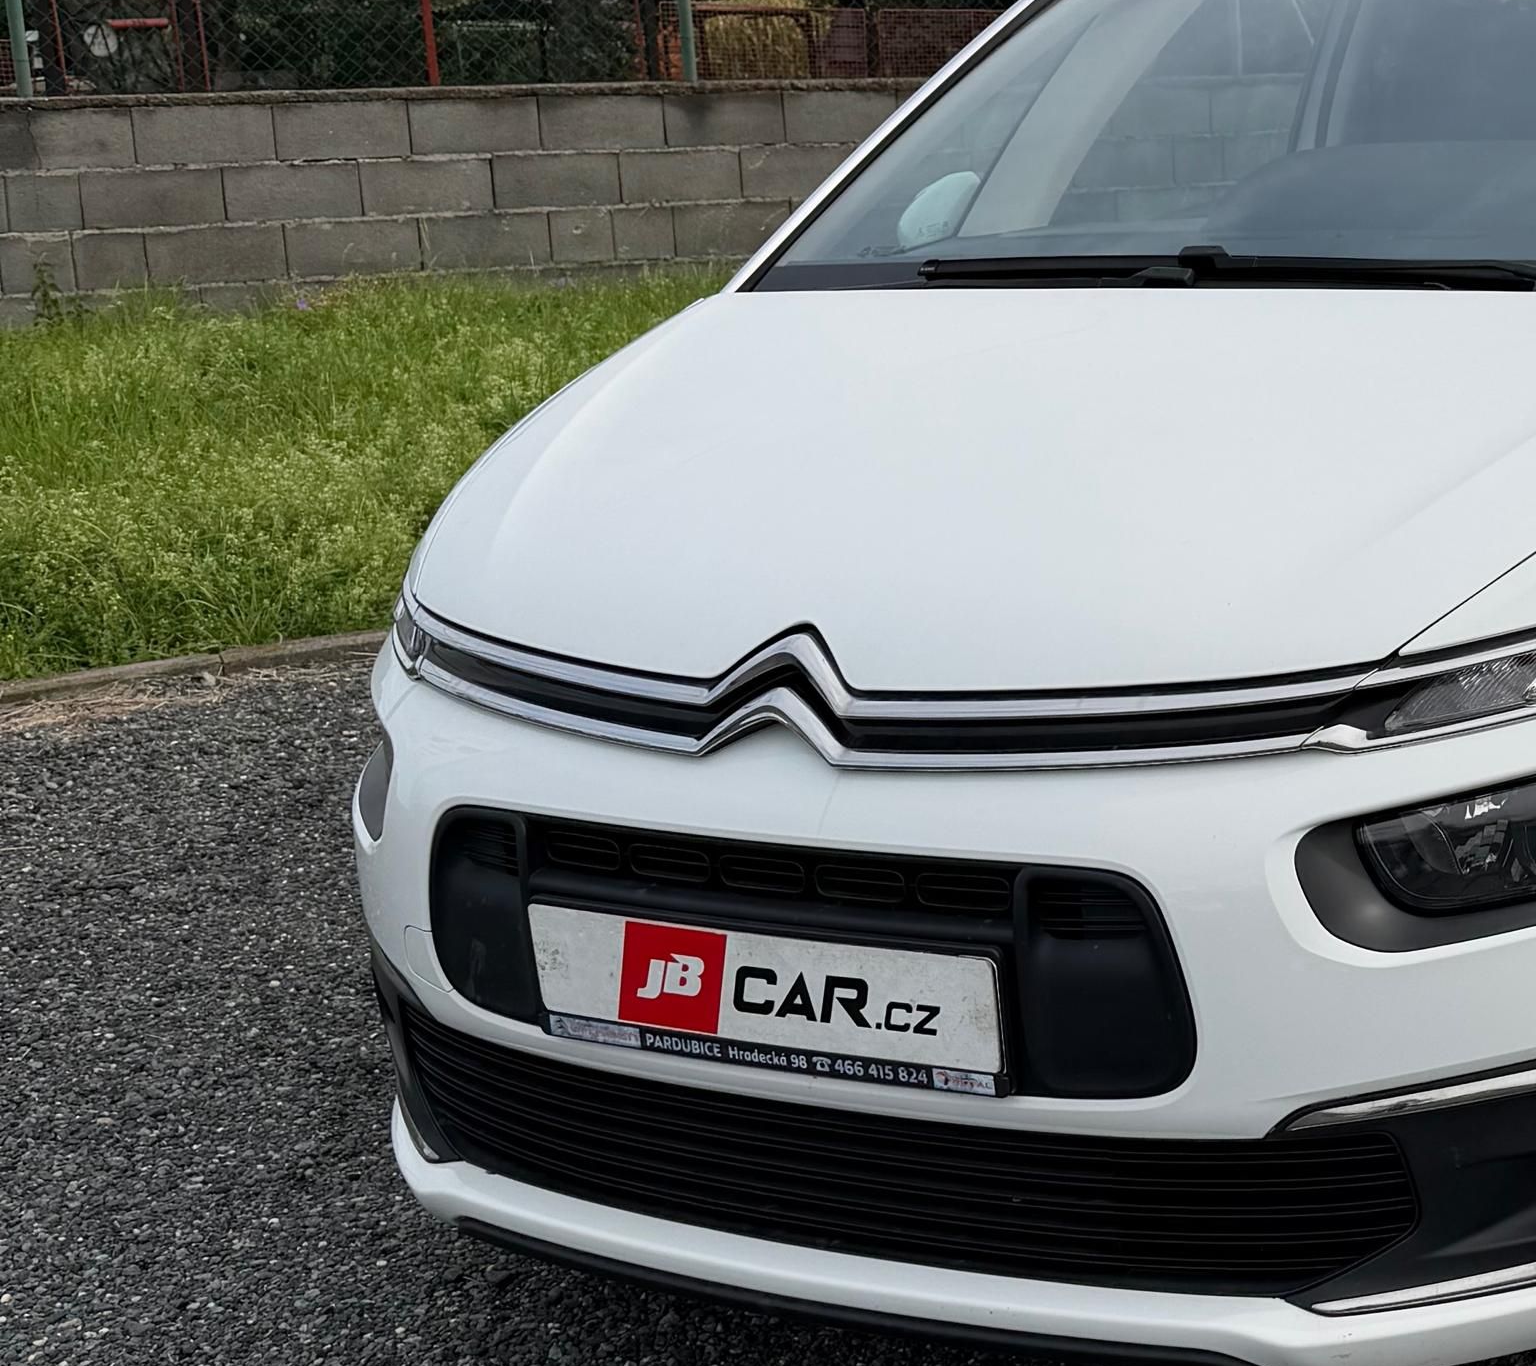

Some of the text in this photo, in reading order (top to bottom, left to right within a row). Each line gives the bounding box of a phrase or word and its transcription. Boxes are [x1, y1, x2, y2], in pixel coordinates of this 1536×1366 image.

[636, 952, 705, 999] JB
[645, 1033, 928, 1084] PARDUBICE Hradecká 98 466 415 824
